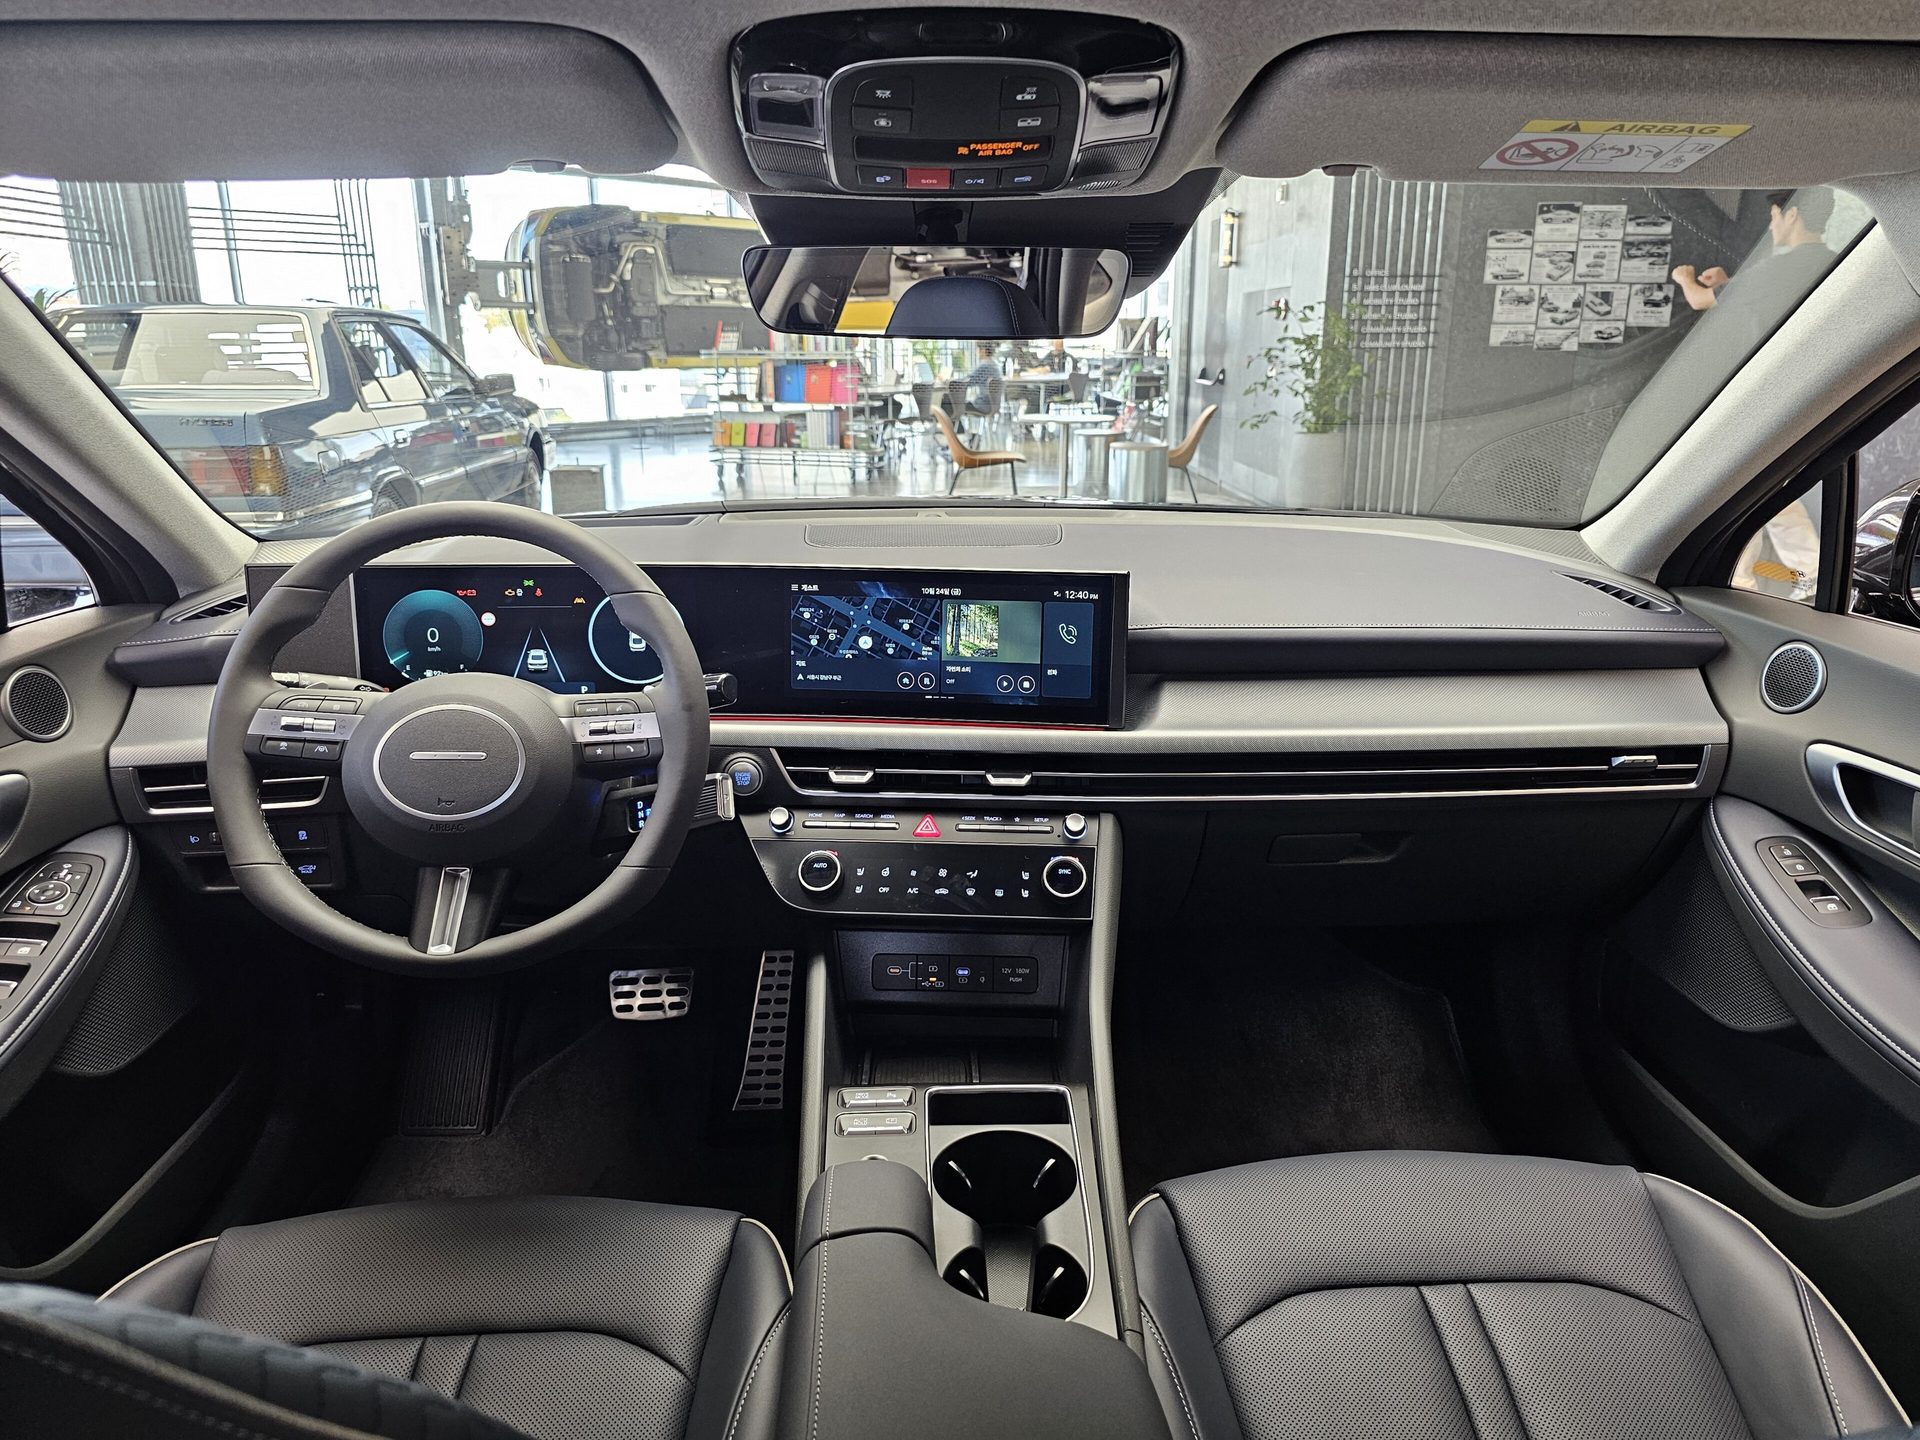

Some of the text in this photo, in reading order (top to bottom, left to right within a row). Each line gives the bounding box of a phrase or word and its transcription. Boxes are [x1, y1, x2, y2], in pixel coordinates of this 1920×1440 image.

[1603, 123, 1722, 135] AIRBAG
[969, 141, 1023, 151] PASSENGER
[1022, 143, 1040, 152] OFF
[977, 148, 1014, 157] AIR BAG
[921, 587, 962, 596] 10월 24일 (금)
[1065, 590, 1089, 600] 12:40
[427, 627, 439, 643] 0
[580, 685, 588, 694] P
[637, 800, 644, 810] D
[637, 810, 645, 819] N
[428, 823, 466, 832] AIRBAG
[638, 819, 645, 828] R
